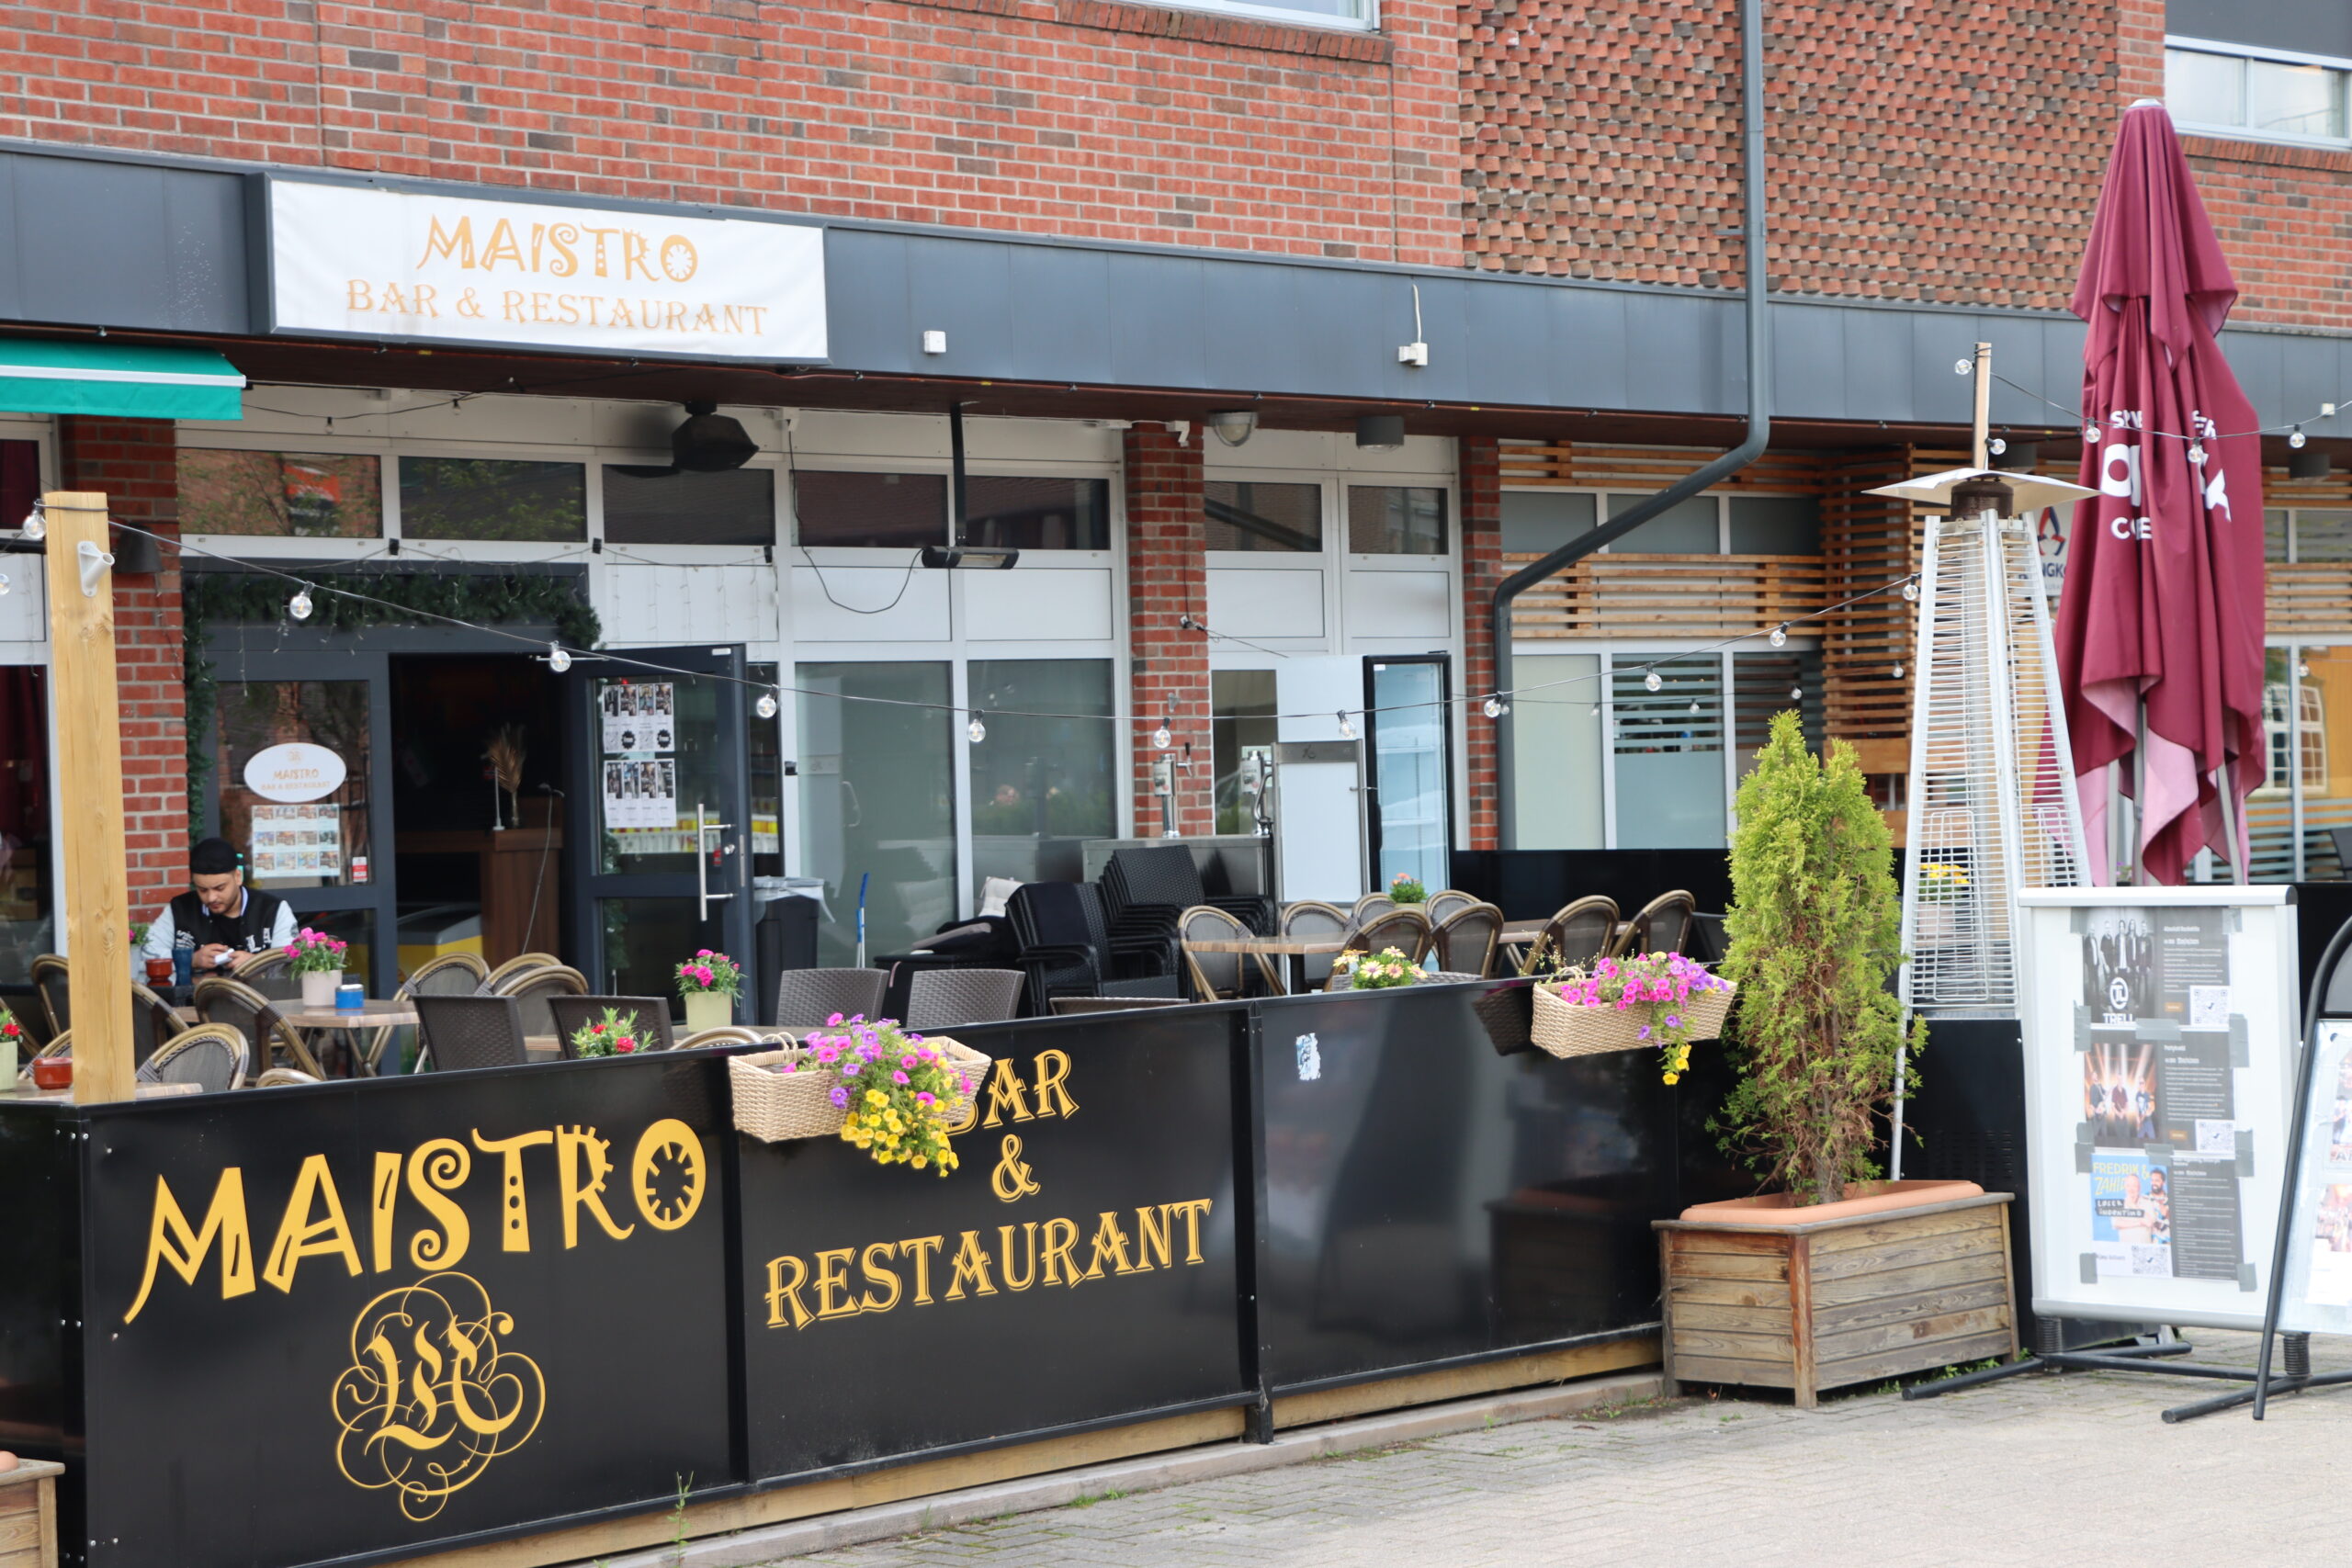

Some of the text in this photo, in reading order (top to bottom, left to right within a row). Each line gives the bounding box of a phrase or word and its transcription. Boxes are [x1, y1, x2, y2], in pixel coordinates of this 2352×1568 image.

[416, 214, 698, 283] MAISTRO
[347, 278, 768, 336] BAR & RESTAURANT
[944, 1048, 1080, 1136] AR
[991, 1133, 1041, 1202] &
[123, 1118, 707, 1324] MAISTRO
[764, 1198, 1213, 1331] RESTAURANT
